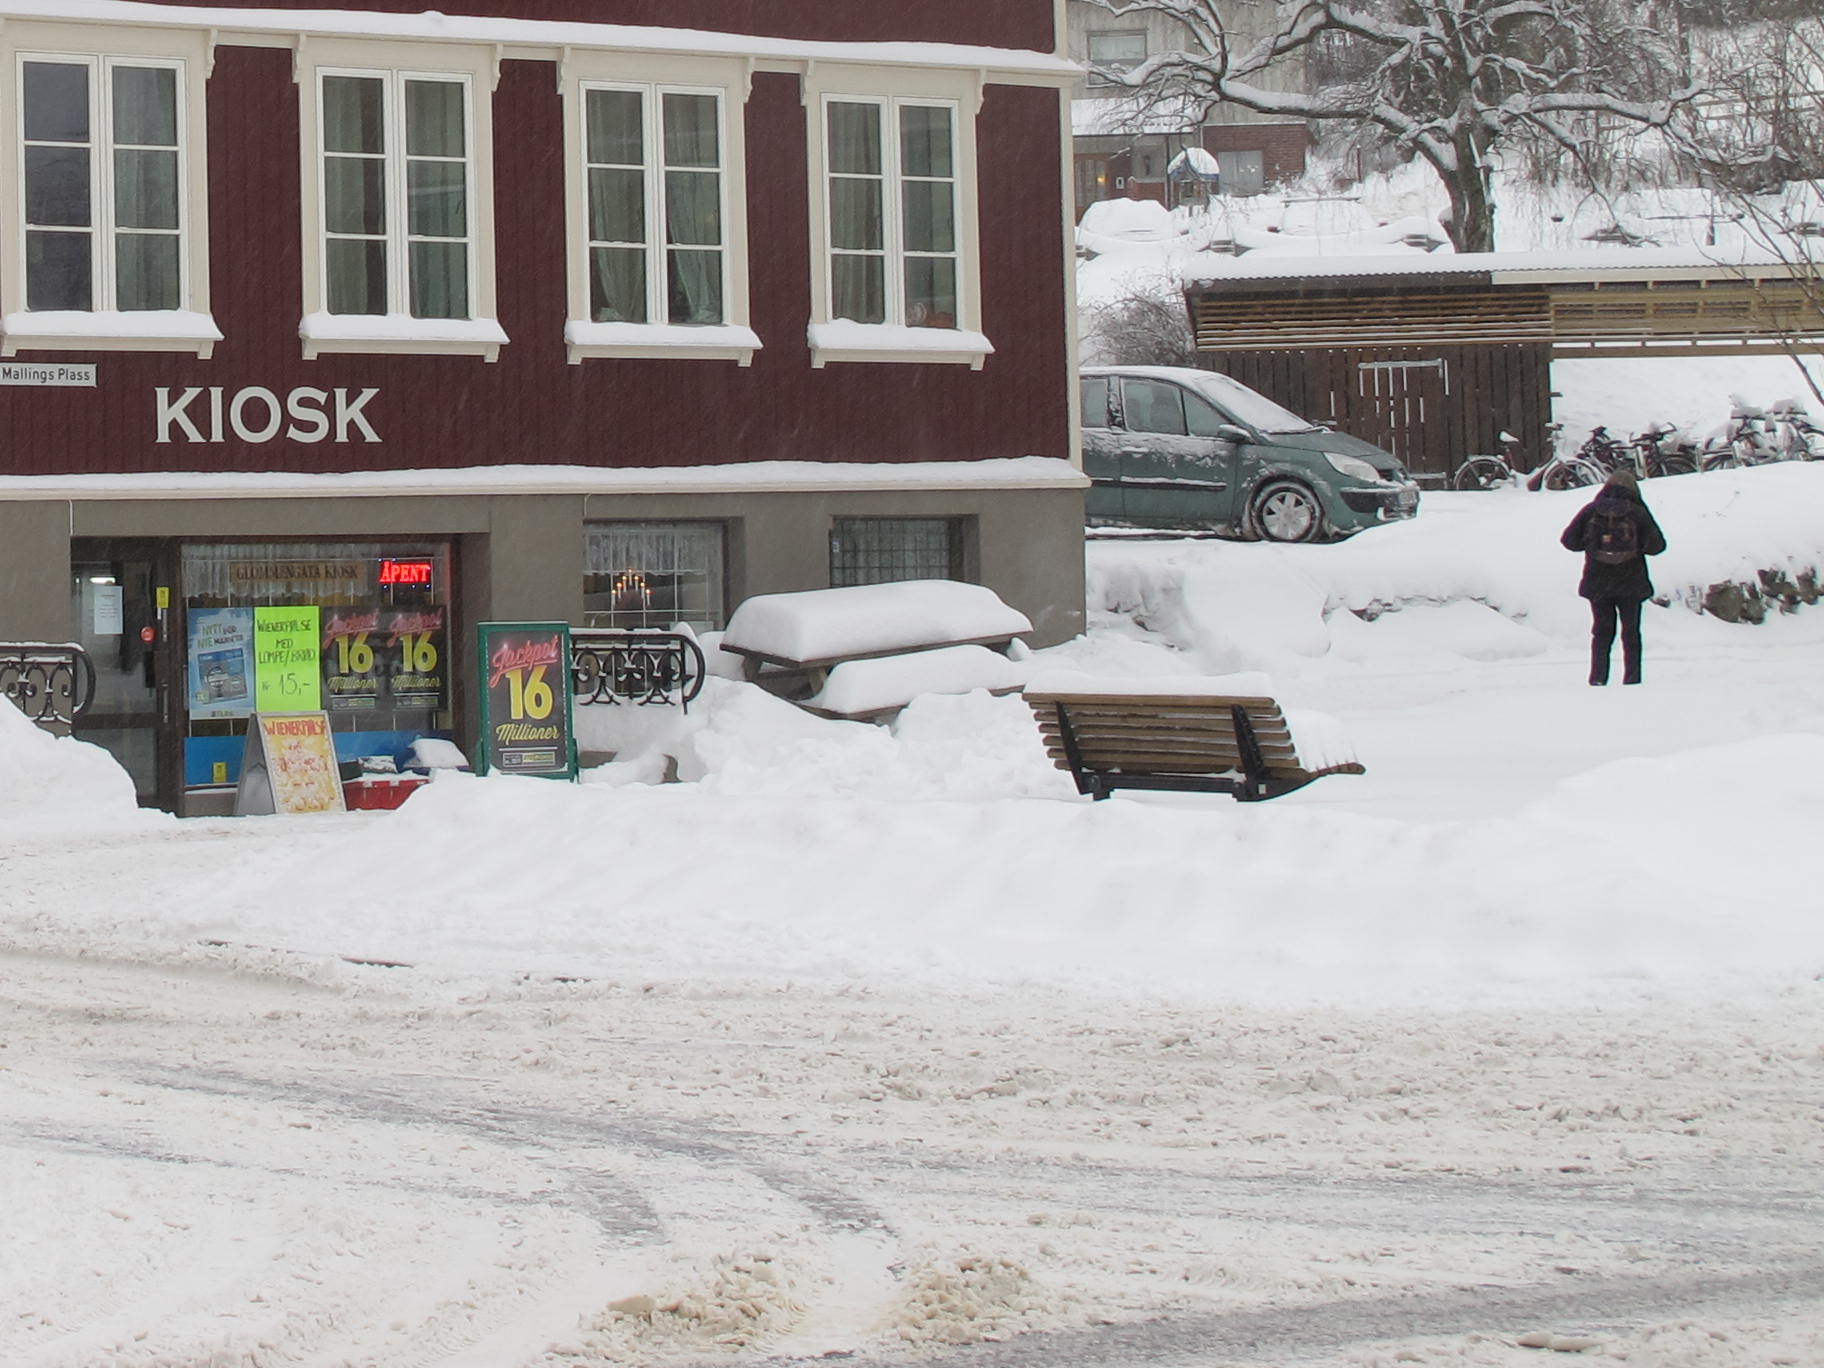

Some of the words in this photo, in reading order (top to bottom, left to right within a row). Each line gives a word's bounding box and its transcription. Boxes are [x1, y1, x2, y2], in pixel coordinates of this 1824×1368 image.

[2, 367, 54, 383] Mallings
[58, 368, 90, 381] Plass
[154, 385, 383, 444] KIOSK
[379, 561, 431, 583] ÅPENT
[275, 638, 294, 649] MED
[336, 632, 374, 673] 16
[400, 631, 437, 672] 16
[489, 635, 558, 688] Jackpot
[327, 676, 378, 692] Millioner
[391, 675, 441, 690] Millioner
[505, 665, 553, 720] 16
[496, 724, 559, 745] Millioner
